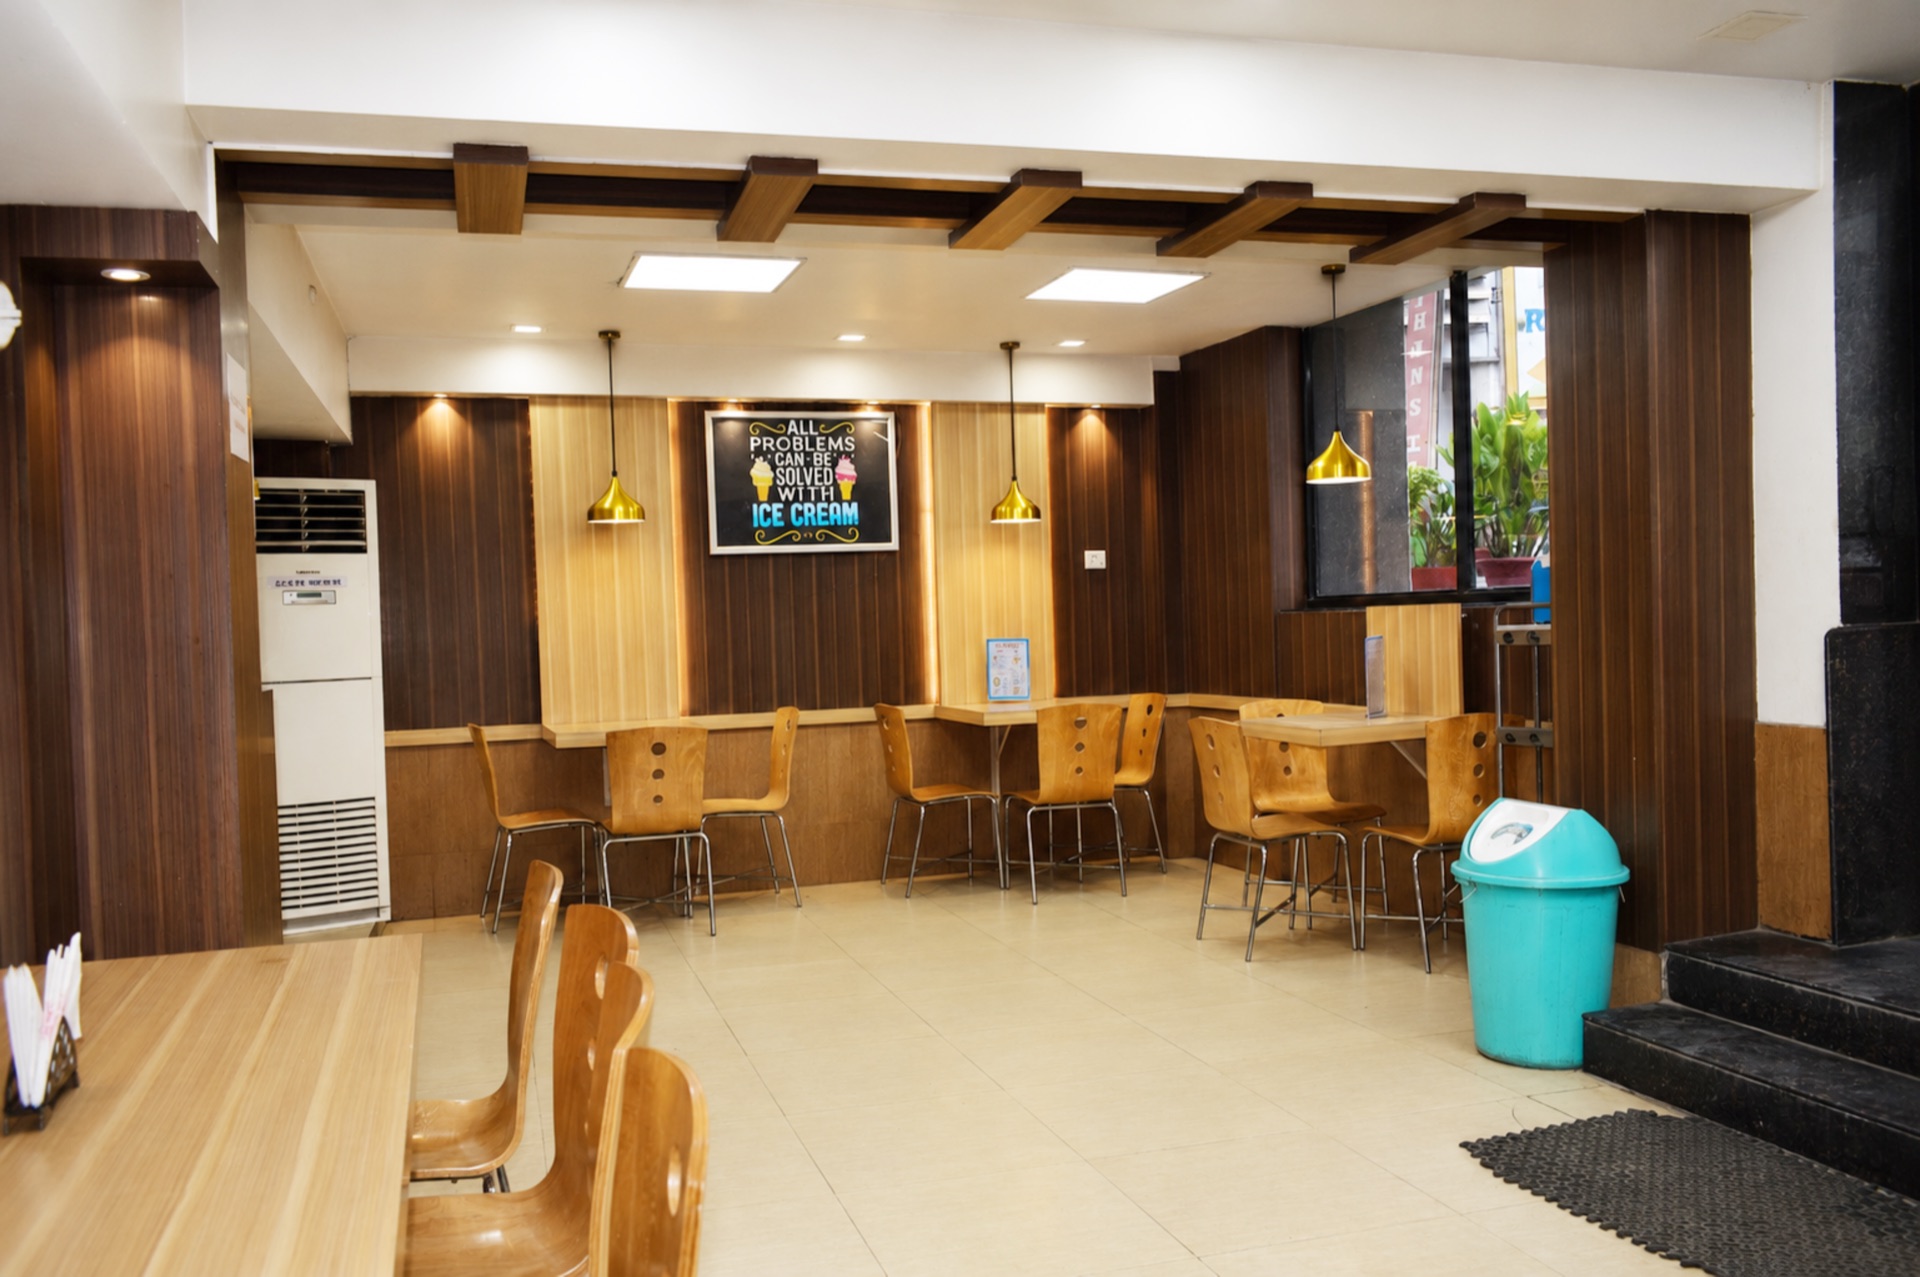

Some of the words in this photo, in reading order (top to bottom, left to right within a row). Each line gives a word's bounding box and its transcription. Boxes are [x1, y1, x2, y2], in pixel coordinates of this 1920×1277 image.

[787, 419, 819, 436] ALL
[749, 436, 856, 452] PROBLEMS
[775, 452, 805, 467] CAN
[813, 452, 832, 467] BE
[775, 467, 834, 487] SOLVED
[777, 486, 835, 502] WITH
[752, 502, 785, 528] ICE
[790, 502, 859, 527] CREAM
